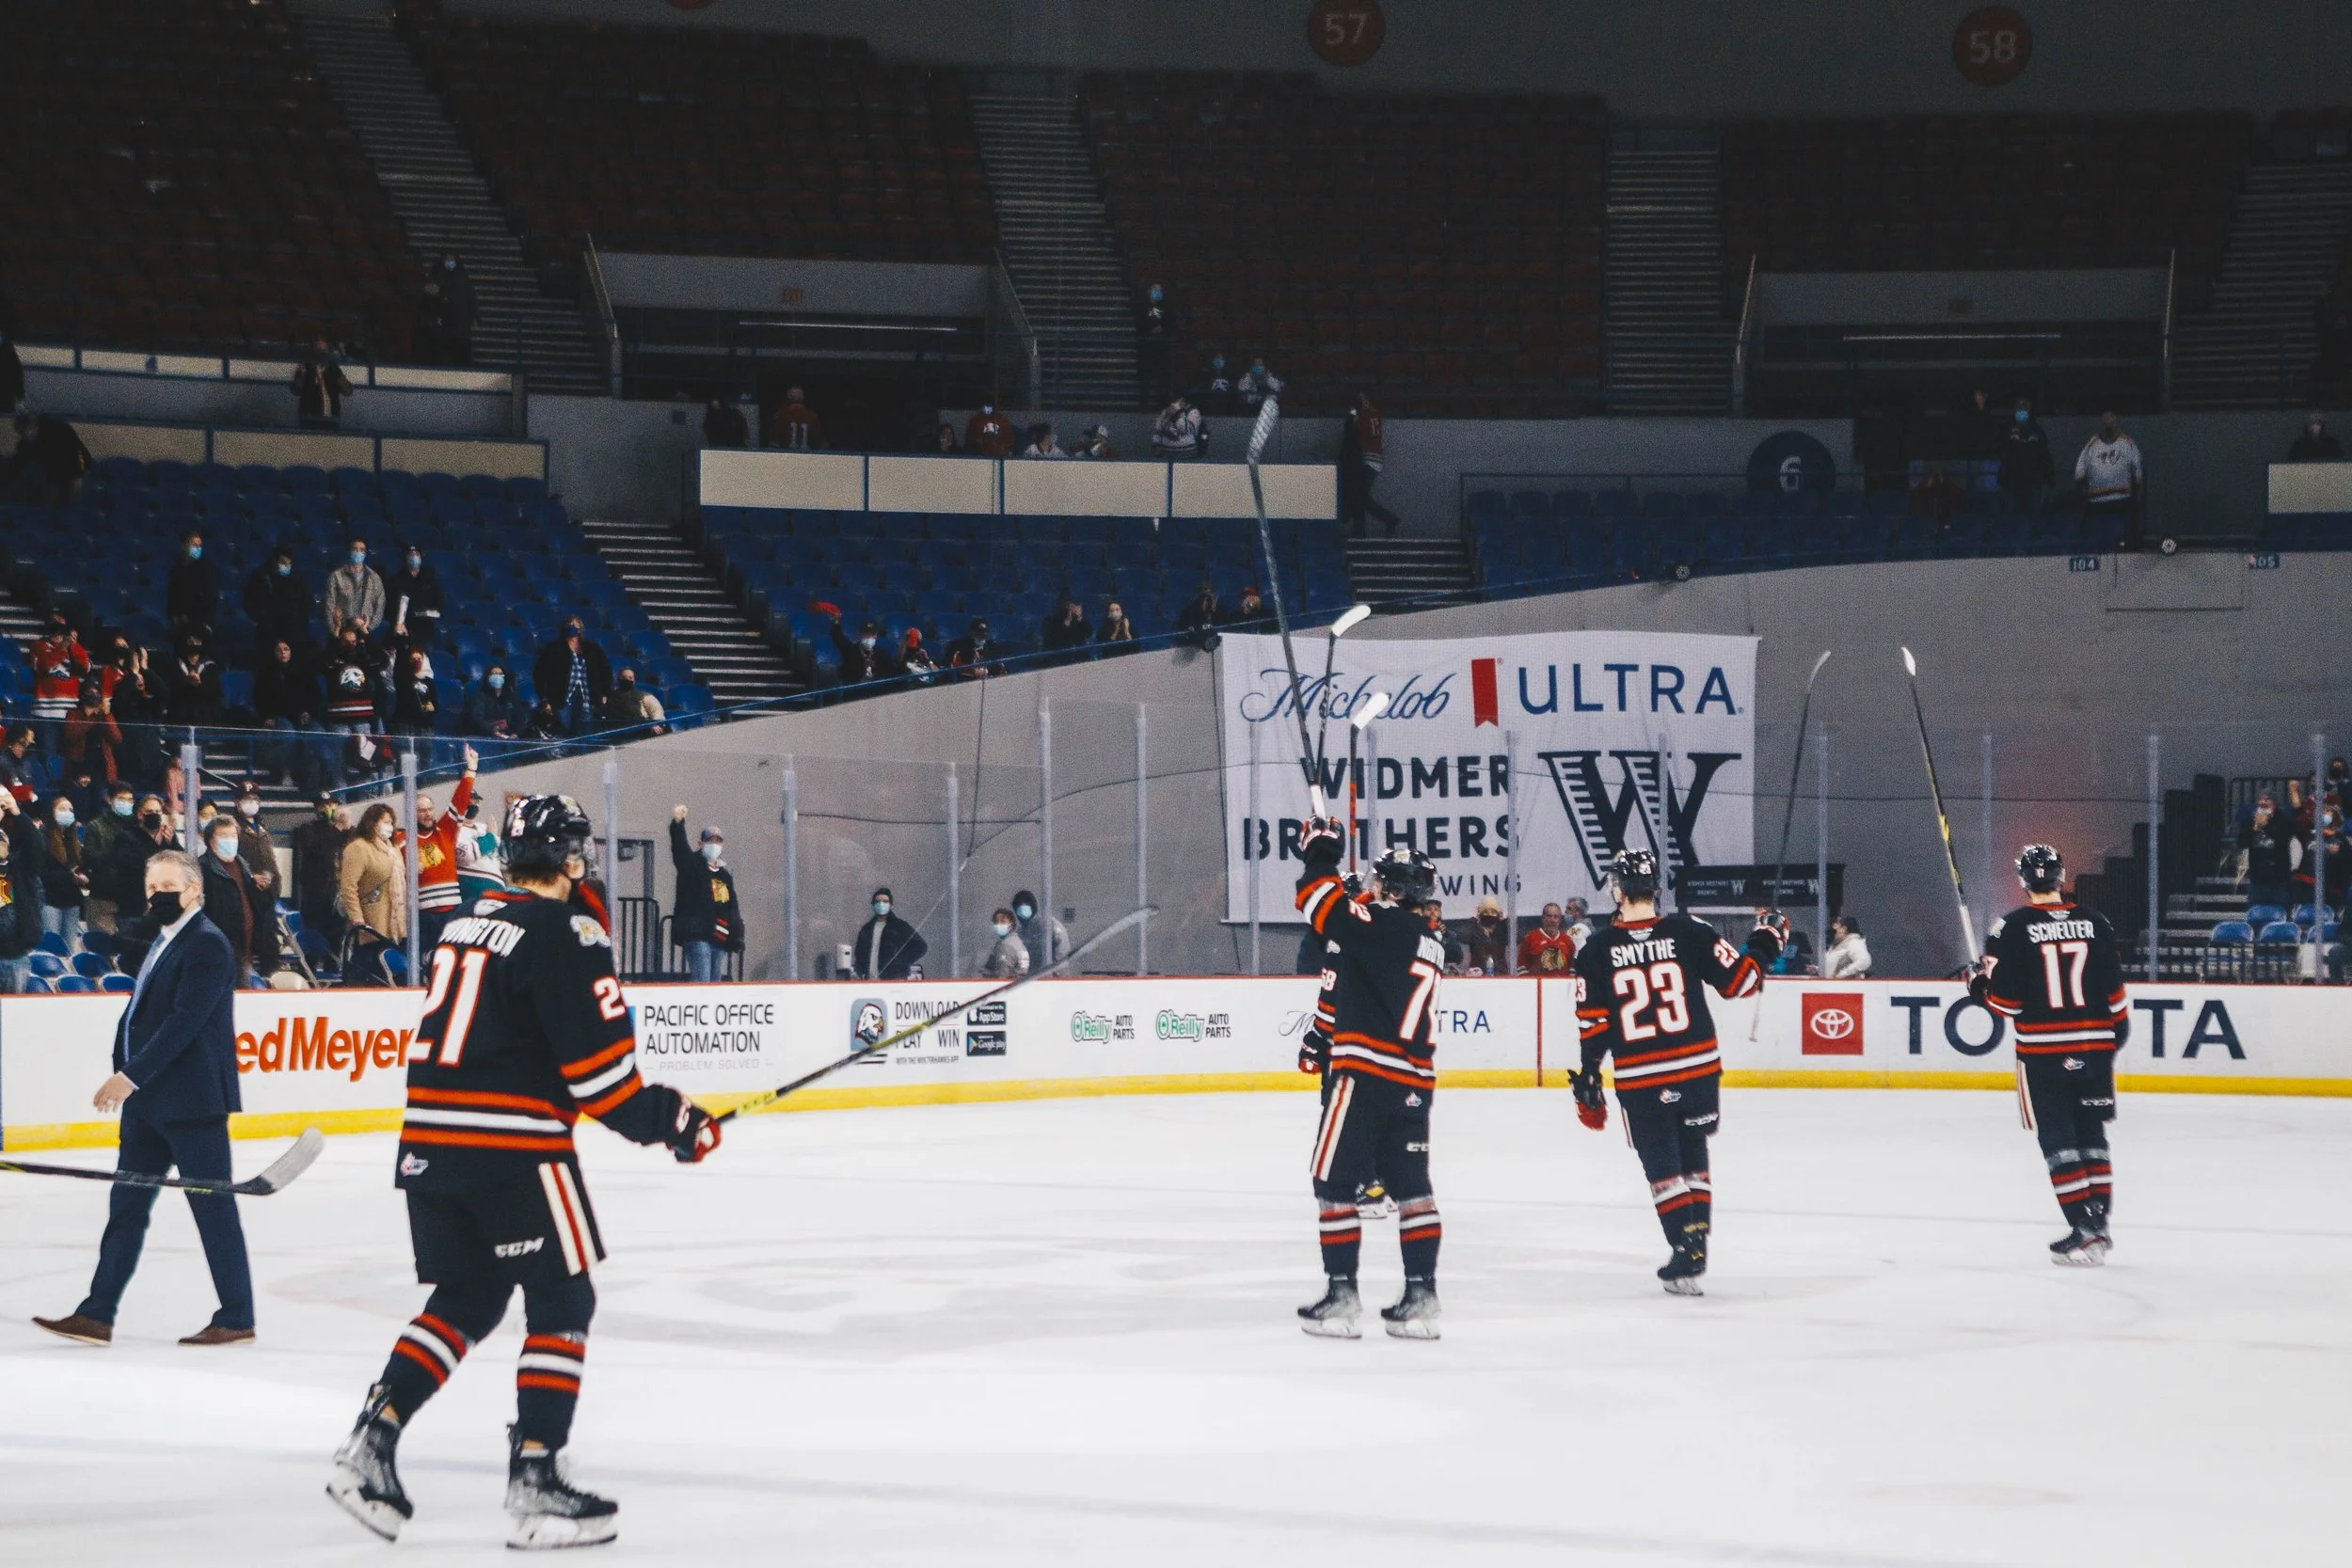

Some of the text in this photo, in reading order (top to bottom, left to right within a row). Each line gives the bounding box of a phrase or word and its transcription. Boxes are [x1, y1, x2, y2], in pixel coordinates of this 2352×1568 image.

[1325, 13, 1367, 45] 57
[1970, 29, 2016, 64] 58
[1779, 455, 1802, 492] 6
[2073, 559, 2094, 570] 104
[1240, 663, 1737, 722] Michlob ULTRA
[1299, 755, 1513, 800] WIDMER
[1243, 815, 1519, 861] BRTHERS
[1439, 874, 1522, 896] WING
[2026, 920, 2095, 943] SCHELTER
[1610, 938, 1677, 969] SMYTHE
[2040, 941, 2089, 1009] 17
[408, 943, 490, 1068] 21
[1612, 960, 1691, 1043] 23
[644, 1004, 774, 1027] PACIFIC OFFICE
[1115, 1015, 1133, 1027] AUTO
[1208, 1014, 1230, 1025] AUTO
[1435, 1010, 1491, 1033] TRA
[1890, 995, 2247, 1060] TOTA
[645, 1031, 761, 1055] AUTOMATION
[937, 1028, 960, 1048] WIN
[1113, 1028, 1136, 1039] PARTS
[1205, 1026, 1232, 1038] PARTS
[660, 1058, 759, 1071] PROBLEM SOLVED
